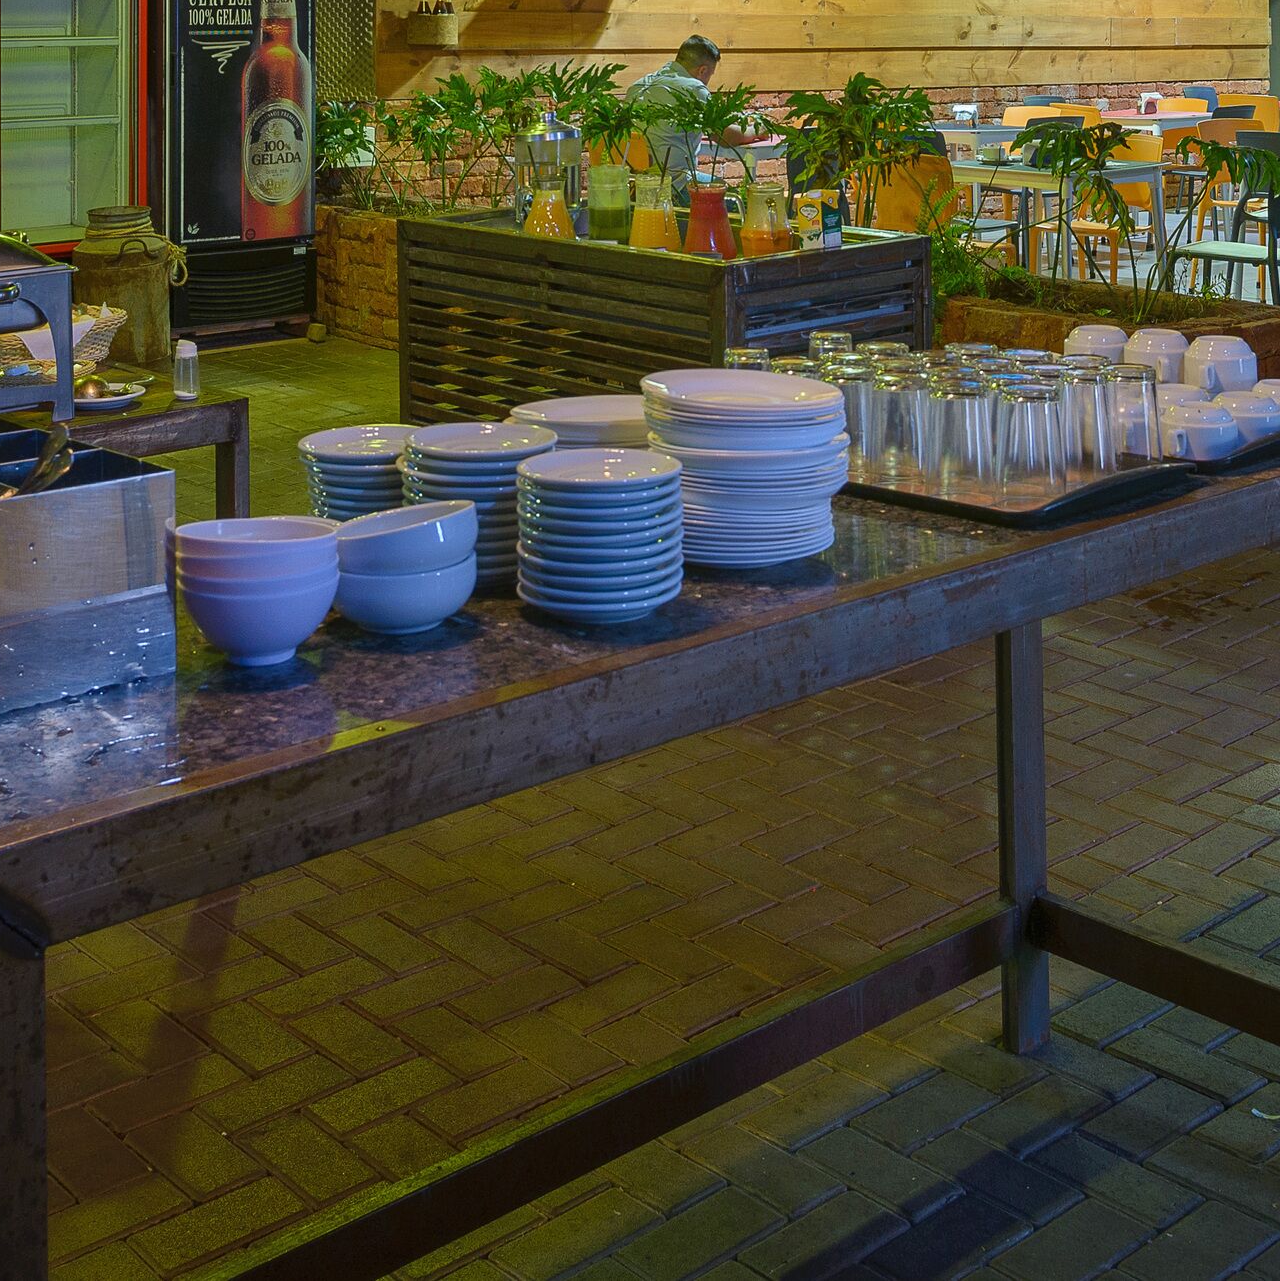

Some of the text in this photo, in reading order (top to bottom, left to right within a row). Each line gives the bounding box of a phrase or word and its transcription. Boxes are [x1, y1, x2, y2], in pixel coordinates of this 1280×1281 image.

[189, 8, 253, 26] 100% GELADA
[251, 151, 302, 166] GELADA
